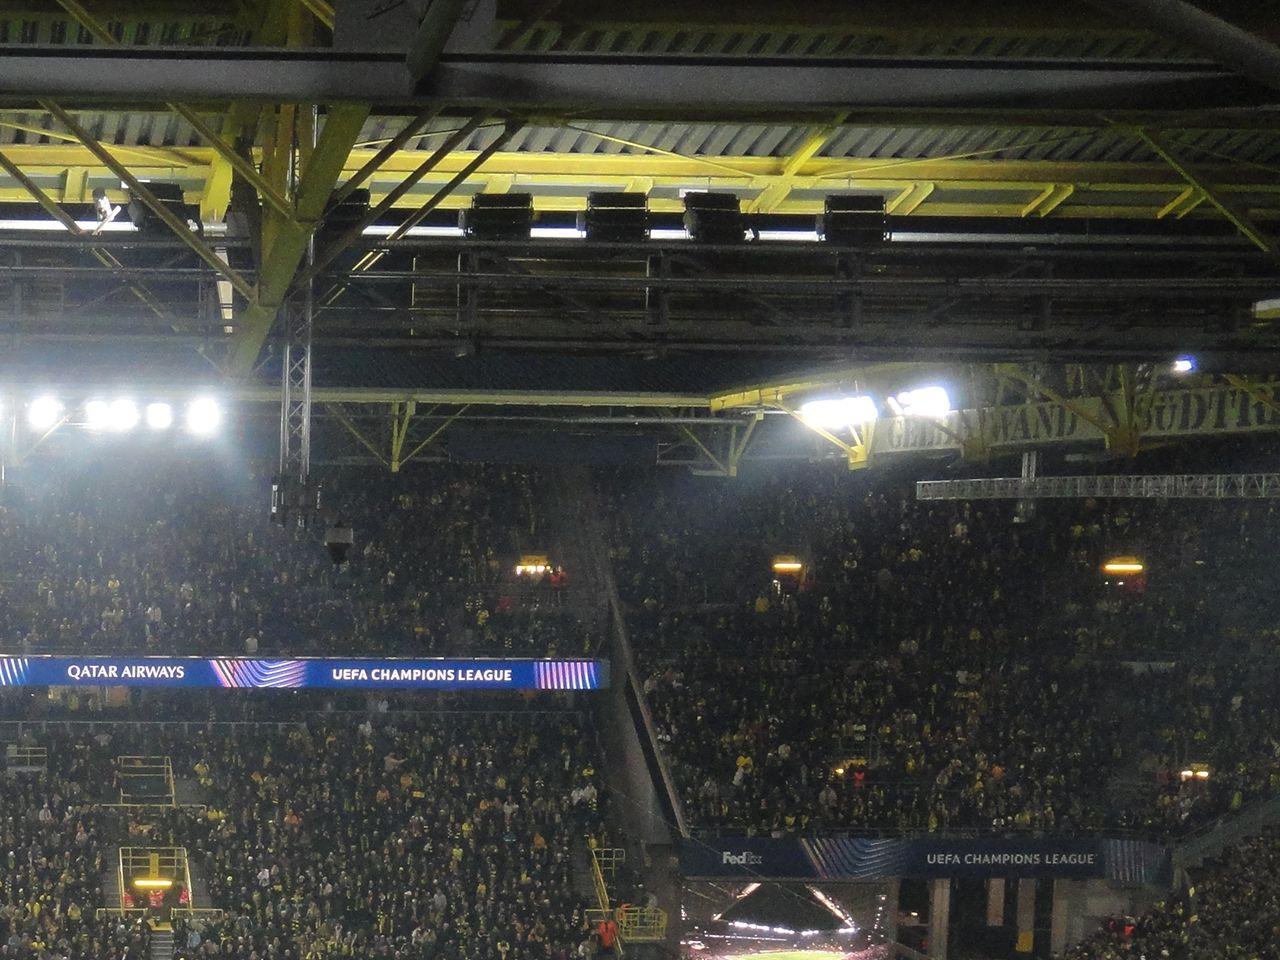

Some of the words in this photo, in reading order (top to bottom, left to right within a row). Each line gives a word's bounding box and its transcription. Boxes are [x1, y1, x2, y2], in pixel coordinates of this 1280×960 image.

[67, 664, 118, 680] QATAR
[121, 665, 185, 679] AIRWAYS
[332, 668, 368, 680] UEFA
[371, 668, 455, 681] CHAMPIONS
[458, 669, 512, 682] LEAGUE
[927, 854, 961, 865] UEFA
[964, 854, 1040, 865] CHAMPIONS
[1045, 854, 1094, 865] LEAGUE
